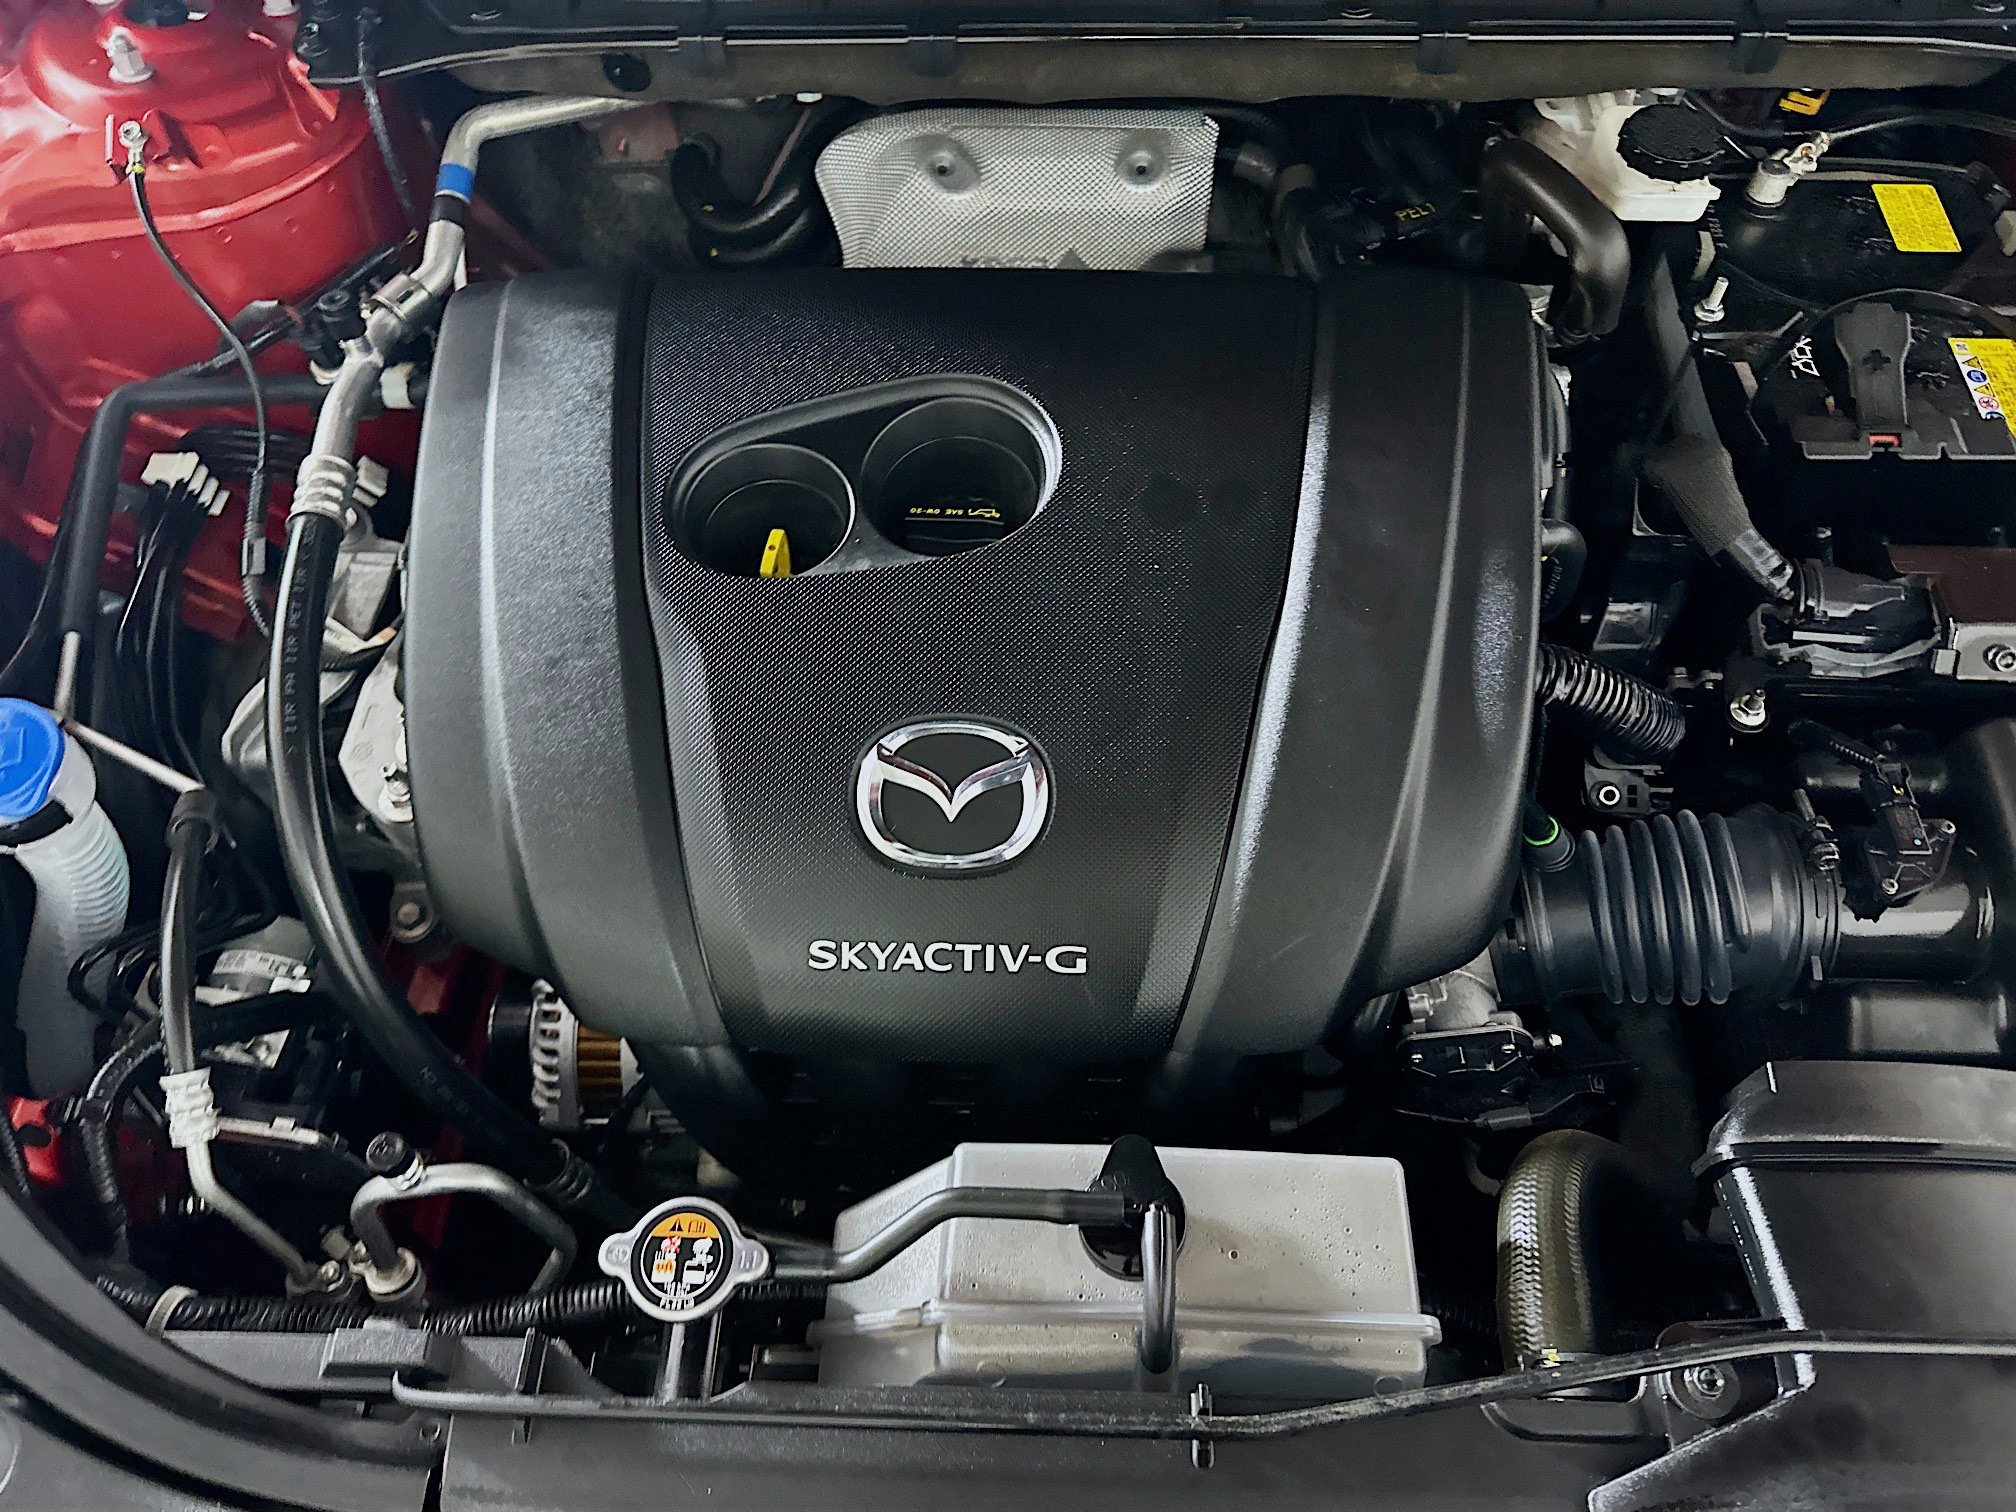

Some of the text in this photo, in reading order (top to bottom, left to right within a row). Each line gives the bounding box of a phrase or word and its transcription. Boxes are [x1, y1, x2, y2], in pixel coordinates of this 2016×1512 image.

[910, 507, 964, 516] SAE 0W-20
[807, 939, 1088, 974] SKYACTIV-G
